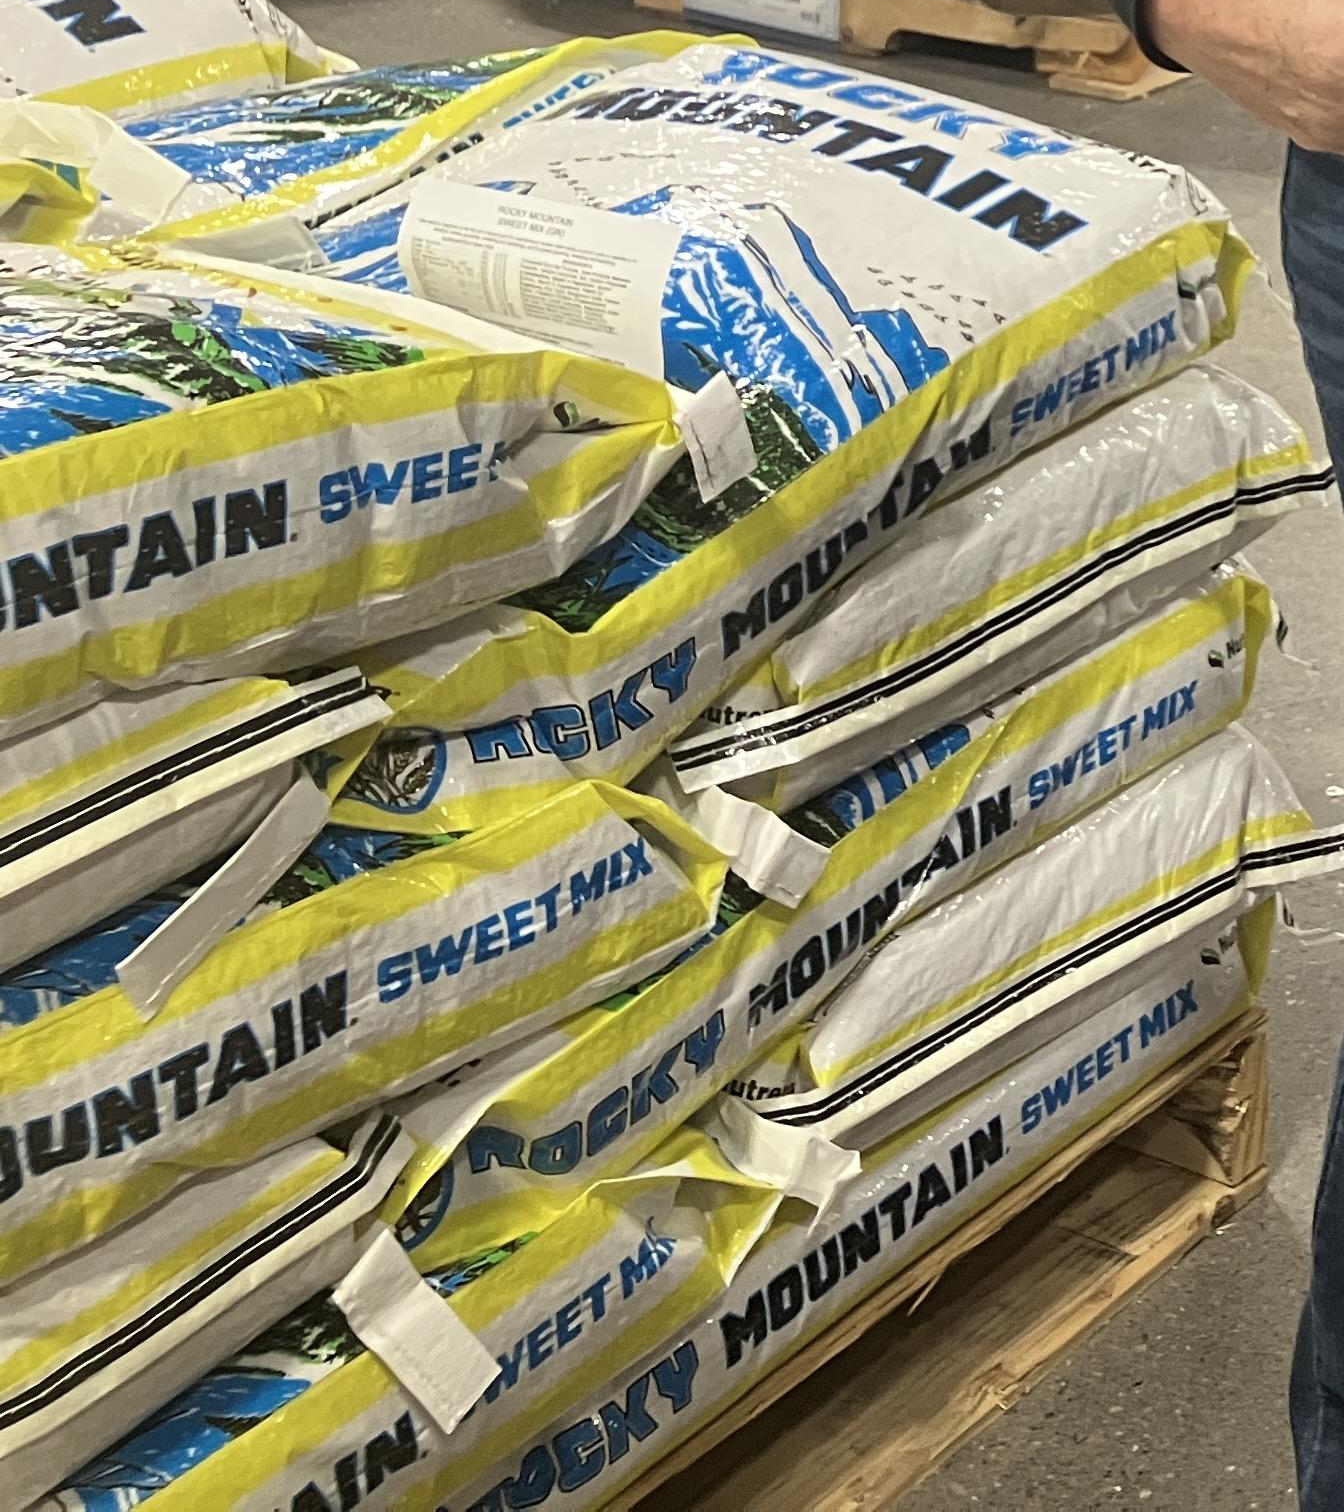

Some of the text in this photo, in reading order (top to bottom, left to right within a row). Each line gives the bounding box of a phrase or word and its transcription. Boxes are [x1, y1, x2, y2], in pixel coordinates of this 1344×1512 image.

[1010, 348, 1122, 441] SWEET
[1124, 309, 1179, 380] MIX
[0, 480, 298, 634] NTAIN.
[0, 836, 655, 1208] UNTAIN. SWEET MIX
[467, 1010, 726, 1176] ROCKY
[1028, 716, 1137, 812] SWEET
[1140, 679, 1200, 736] MIX
[438, 1339, 701, 1512] OCKY
[1021, 1032, 1132, 1136] SWEET
[1136, 979, 1201, 1051] MIX
[475, 1281, 611, 1413] WEET
